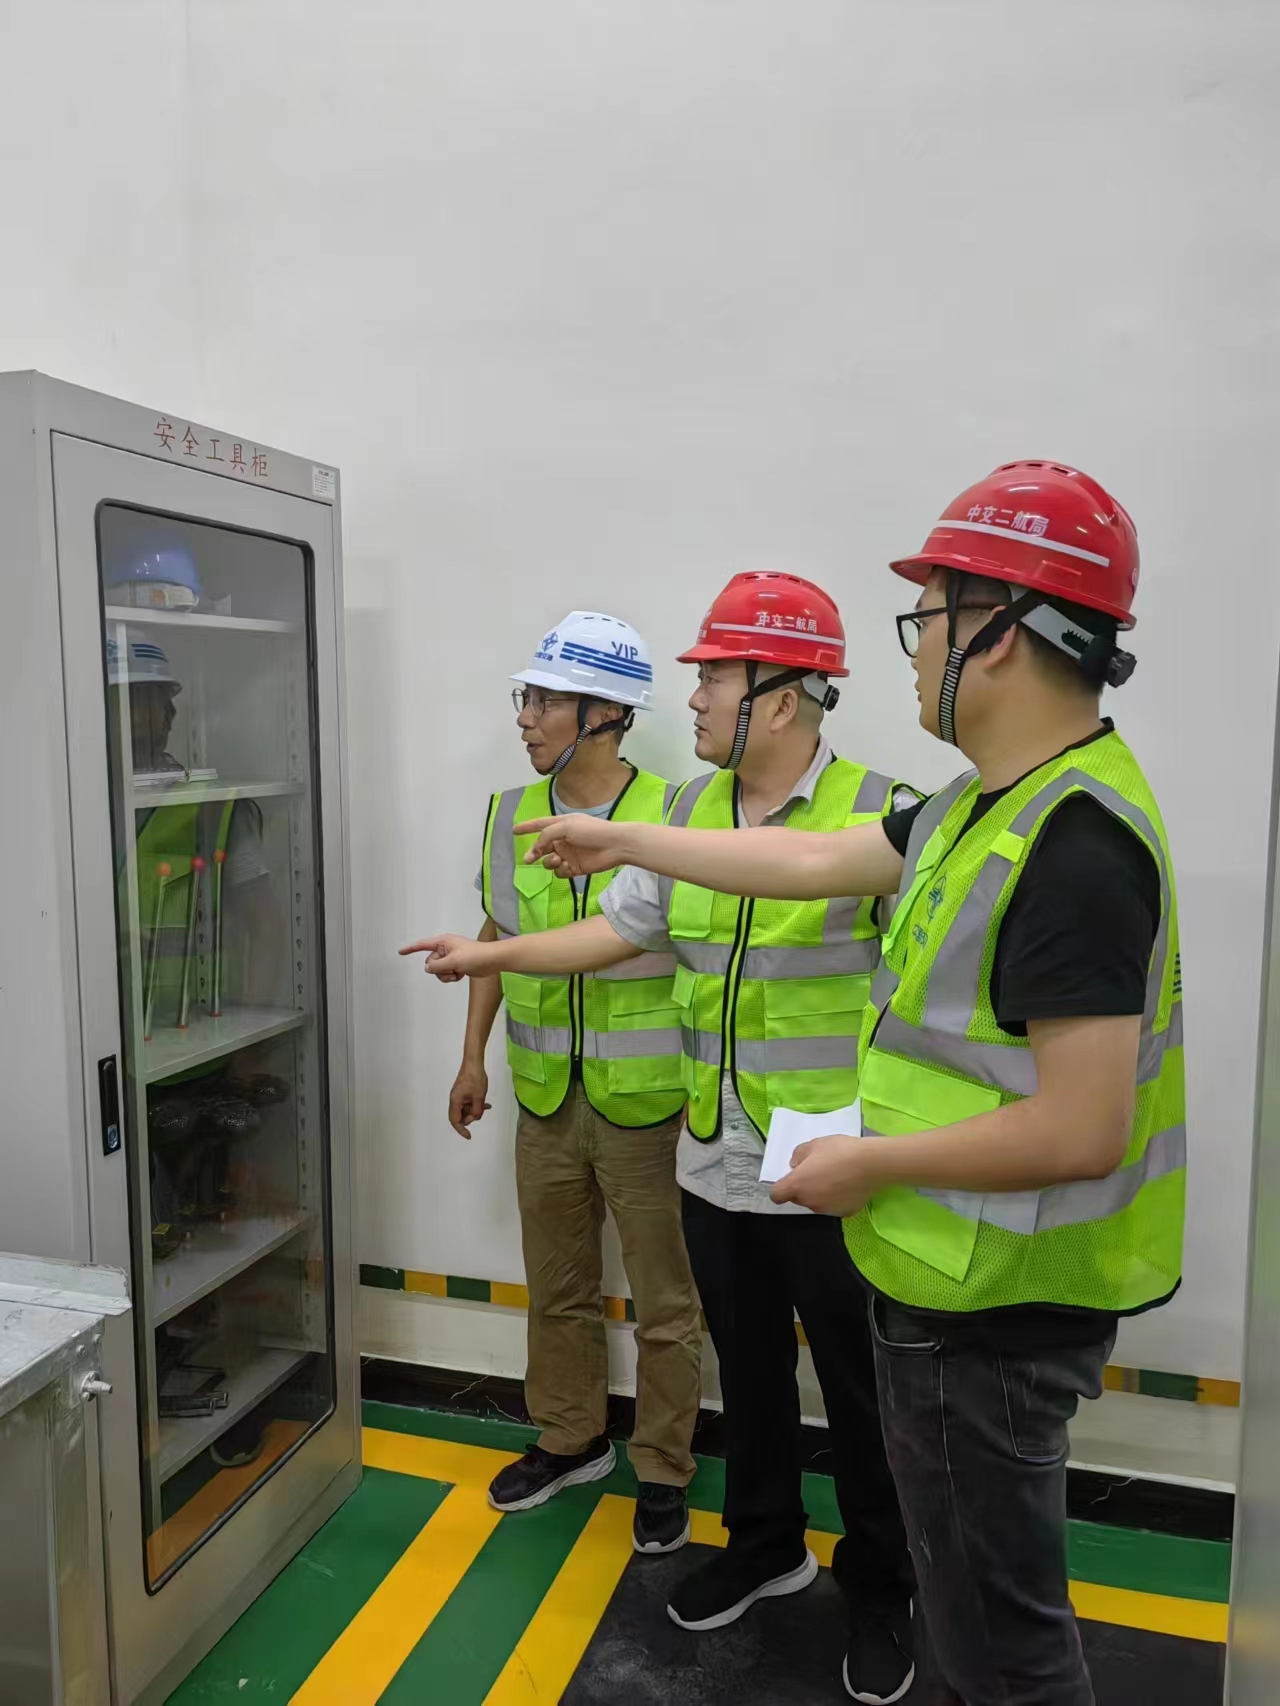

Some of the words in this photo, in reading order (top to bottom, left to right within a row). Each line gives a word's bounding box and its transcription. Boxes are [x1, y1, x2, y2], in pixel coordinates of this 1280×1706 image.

[153, 416, 269, 478] 安全工具柜
[967, 503, 1051, 537] 中交二航局
[755, 611, 818, 633] 中交二航局
[610, 640, 639, 661] VIP
